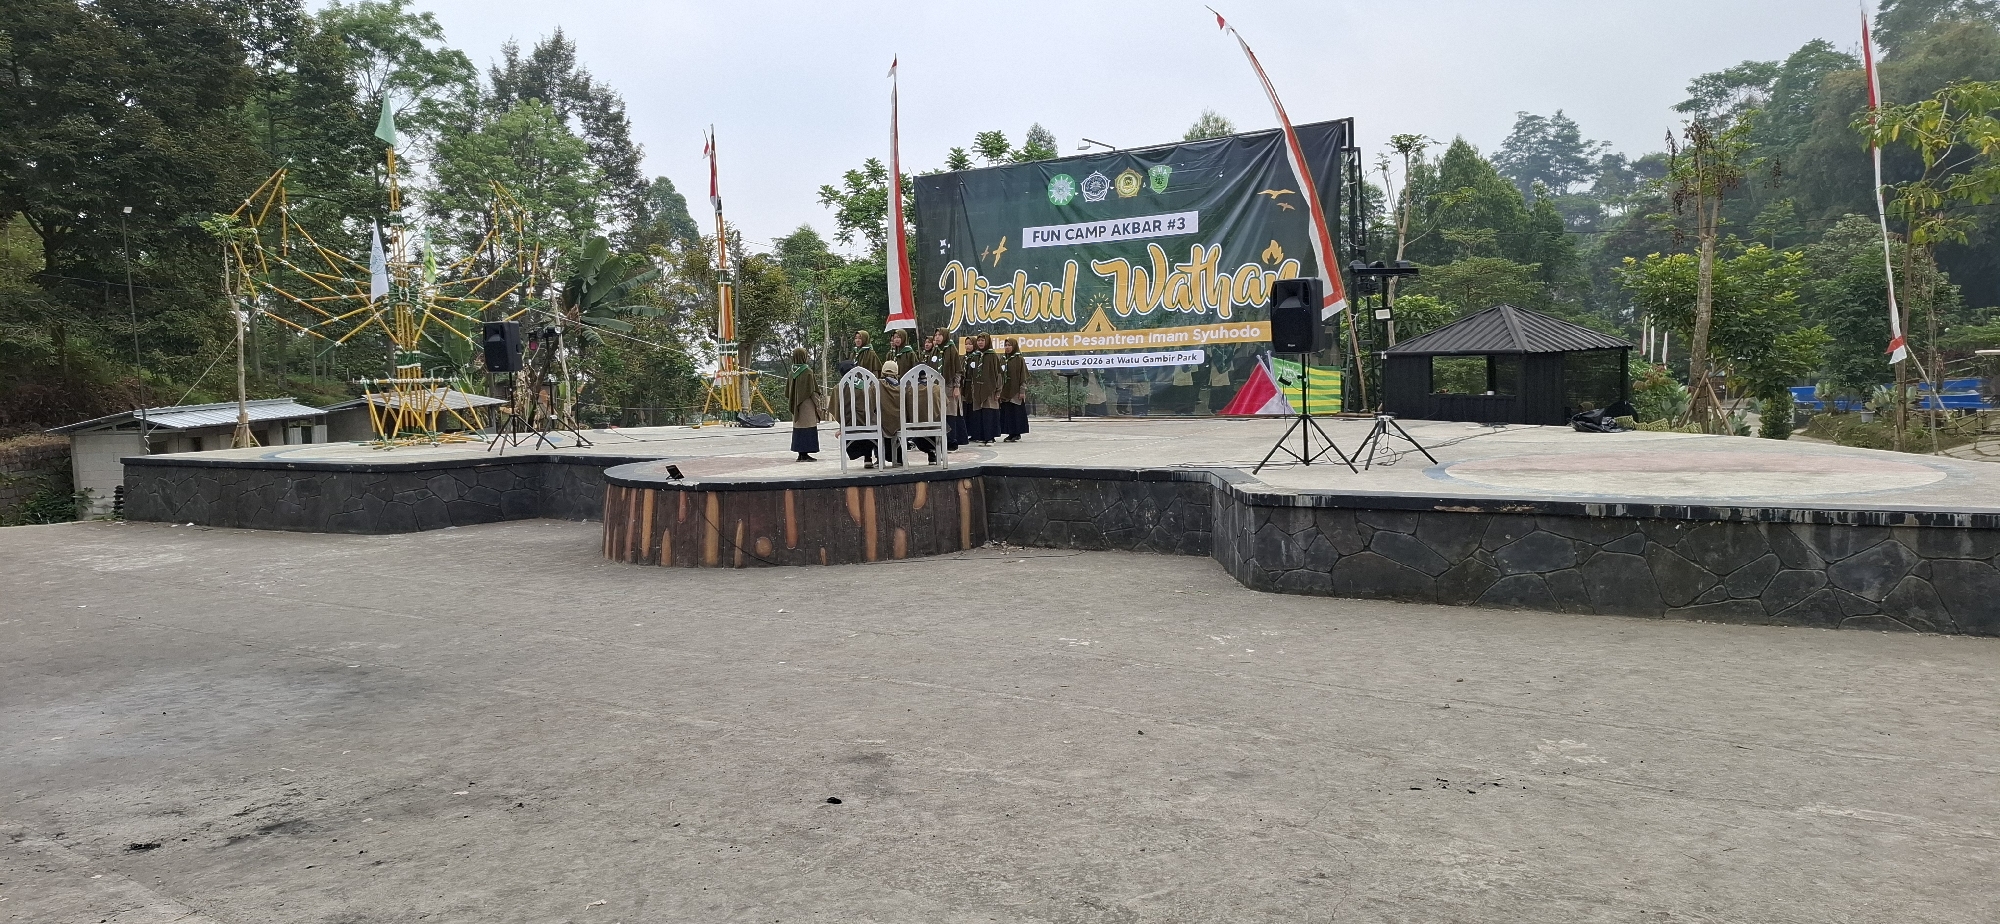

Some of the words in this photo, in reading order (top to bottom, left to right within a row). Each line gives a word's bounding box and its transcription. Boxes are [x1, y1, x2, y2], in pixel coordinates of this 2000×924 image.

[1032, 229, 1061, 243] FUN
[1064, 225, 1107, 240] CAMP
[1110, 219, 1162, 237] AKBAR
[1167, 217, 1186, 231] #3
[939, 259, 1078, 334] Hizbul
[1018, 334, 1069, 348] Pondok
[1073, 333, 1144, 346] Pesantren
[1149, 331, 1188, 343] Imam
[1192, 325, 1261, 343] Syuhodo
[1031, 359, 1042, 367] 20
[1044, 358, 1079, 368] Agustus
[1081, 357, 1103, 366] 2026
[1105, 357, 1114, 365] at
[1117, 356, 1140, 364] Watu
[1142, 354, 1175, 363] Gambir
[1177, 353, 1197, 362] Park
